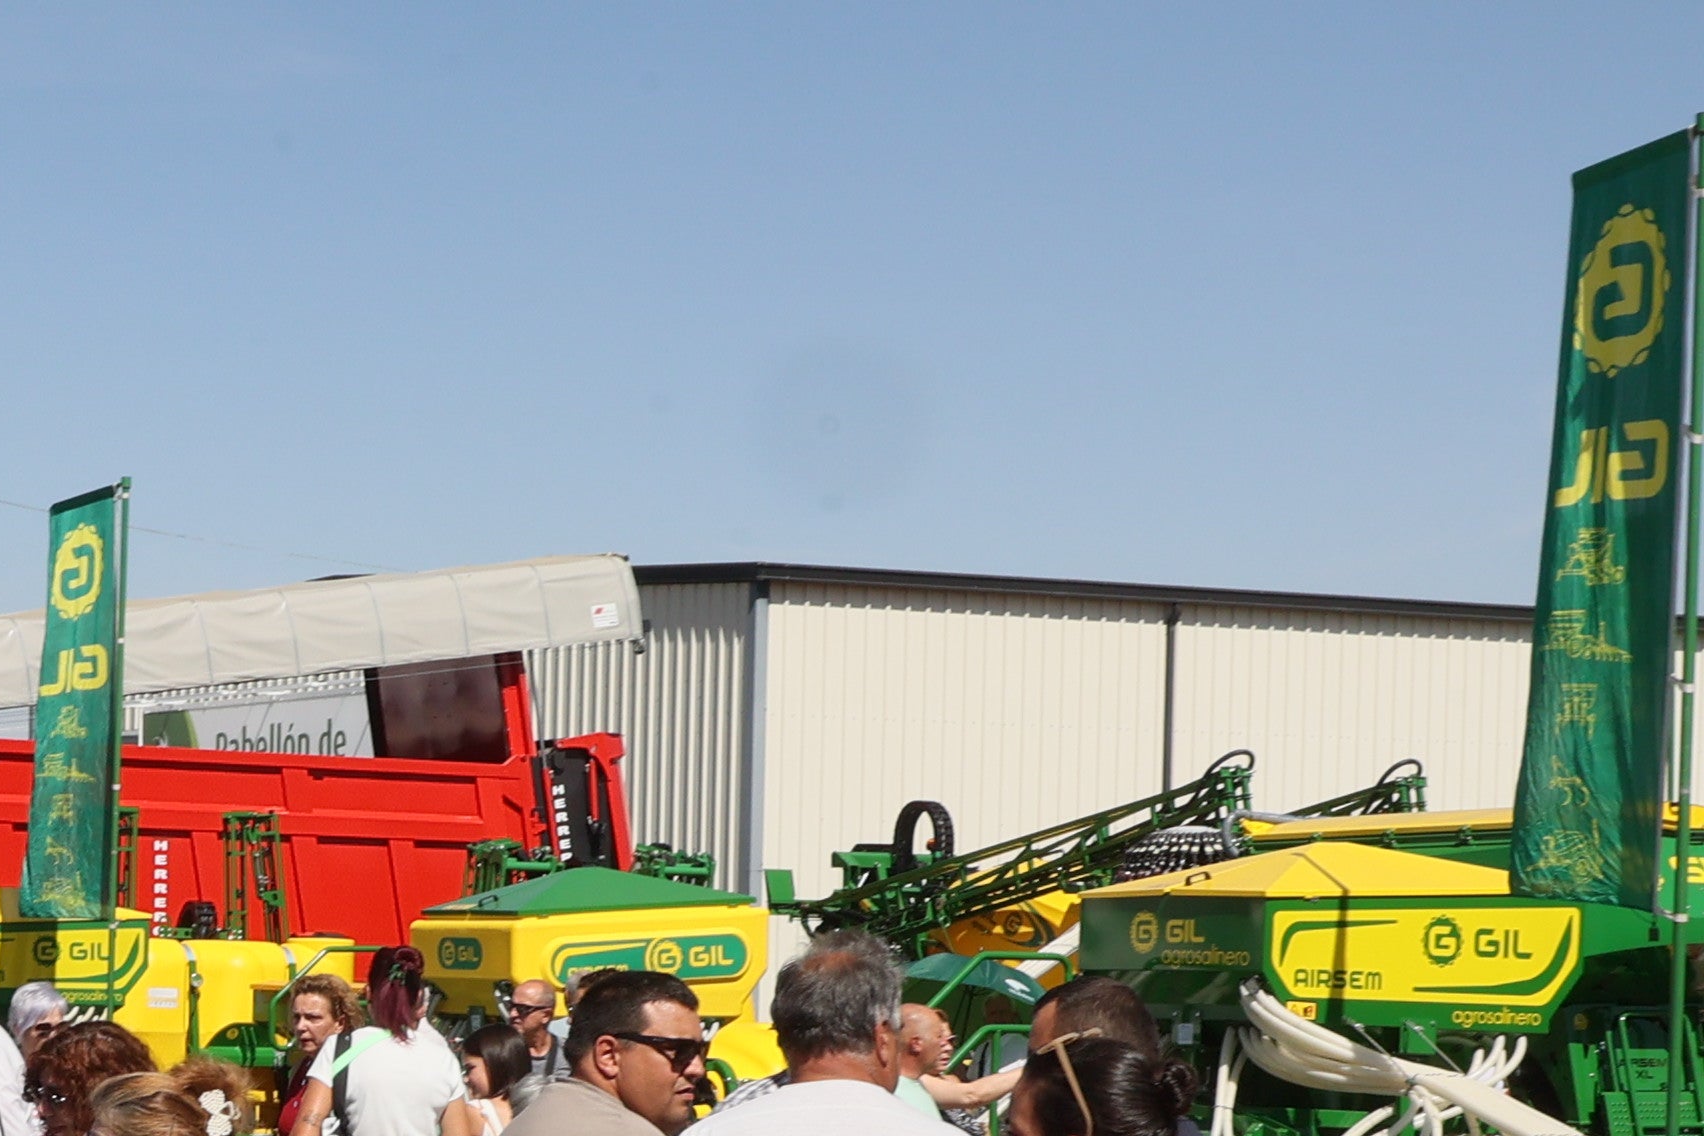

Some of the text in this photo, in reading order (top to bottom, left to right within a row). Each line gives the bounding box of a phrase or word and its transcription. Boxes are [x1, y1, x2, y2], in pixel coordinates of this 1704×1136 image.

[319, 718, 346, 756] de
[1165, 919, 1206, 943] GIL
[69, 942, 110, 961] GIL
[1474, 928, 1532, 960] GIL
[688, 945, 735, 968] GIL
[1294, 968, 1383, 990] AIRSEM
[1451, 1006, 1543, 1028] agrosalinero
